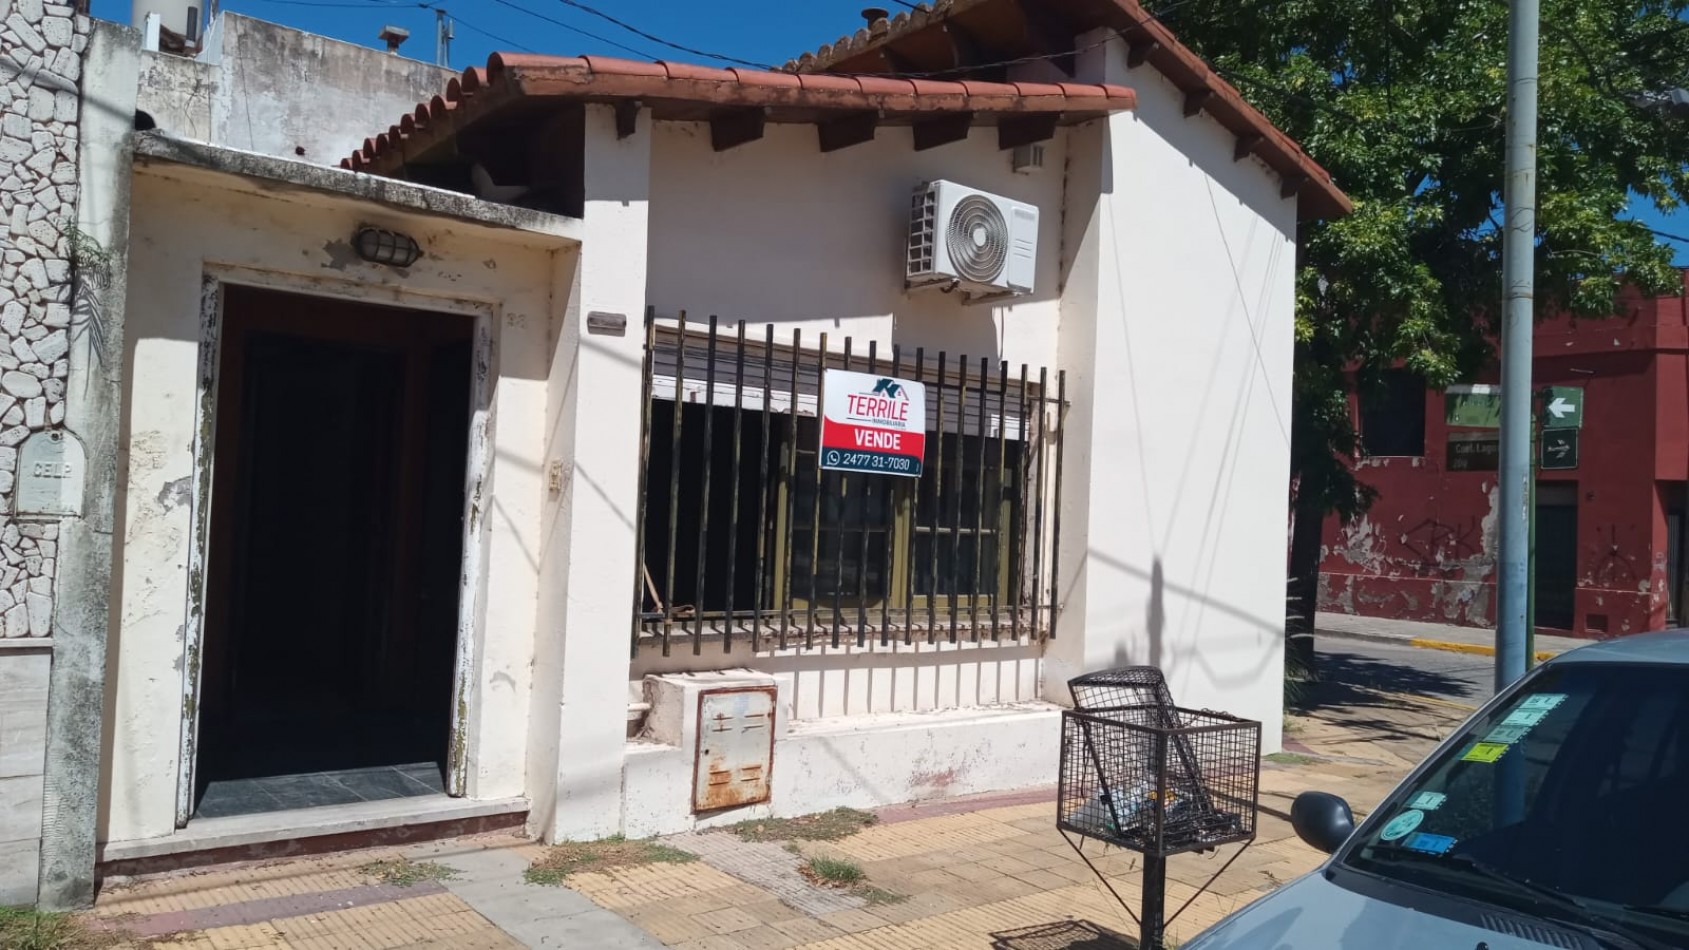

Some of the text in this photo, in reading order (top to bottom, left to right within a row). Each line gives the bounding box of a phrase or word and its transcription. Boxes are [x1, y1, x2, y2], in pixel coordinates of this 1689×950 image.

[848, 394, 909, 421] TERRILE
[855, 428, 901, 450] VENDE
[843, 452, 870, 467] 2477
[872, 455, 910, 471] 31-7030
